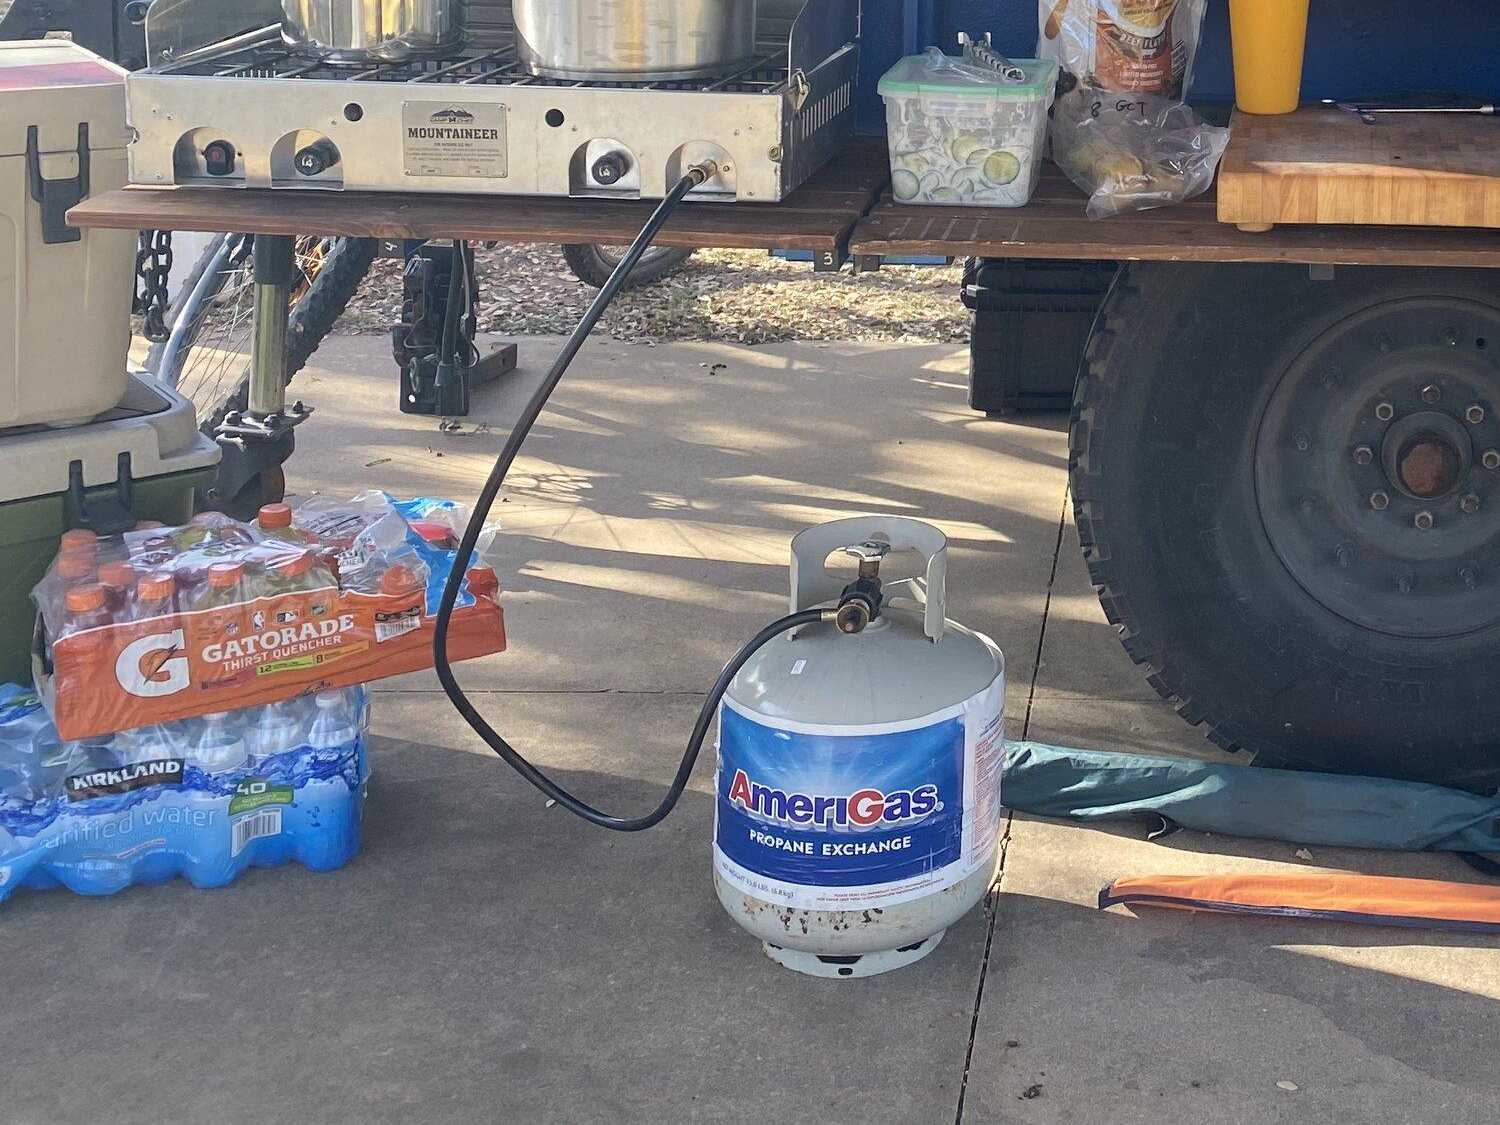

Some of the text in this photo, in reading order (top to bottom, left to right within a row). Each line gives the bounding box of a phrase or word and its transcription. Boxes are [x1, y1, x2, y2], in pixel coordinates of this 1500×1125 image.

[1091, 101, 1102, 117] 8
[407, 127, 499, 140] MOUNTAINEER
[384, 241, 398, 252] 4
[823, 251, 834, 266] 3
[202, 614, 355, 663] GATORADE
[115, 627, 192, 698] G
[223, 651, 269, 672] THIRST
[273, 635, 342, 661] QUENCHER
[259, 664, 273, 674] 12
[72, 761, 181, 790] KIRKLAND
[236, 782, 267, 795] 40
[728, 768, 940, 827] AmeriGas
[143, 805, 218, 827] water
[749, 829, 912, 856] PROPANE EXCHANGE
